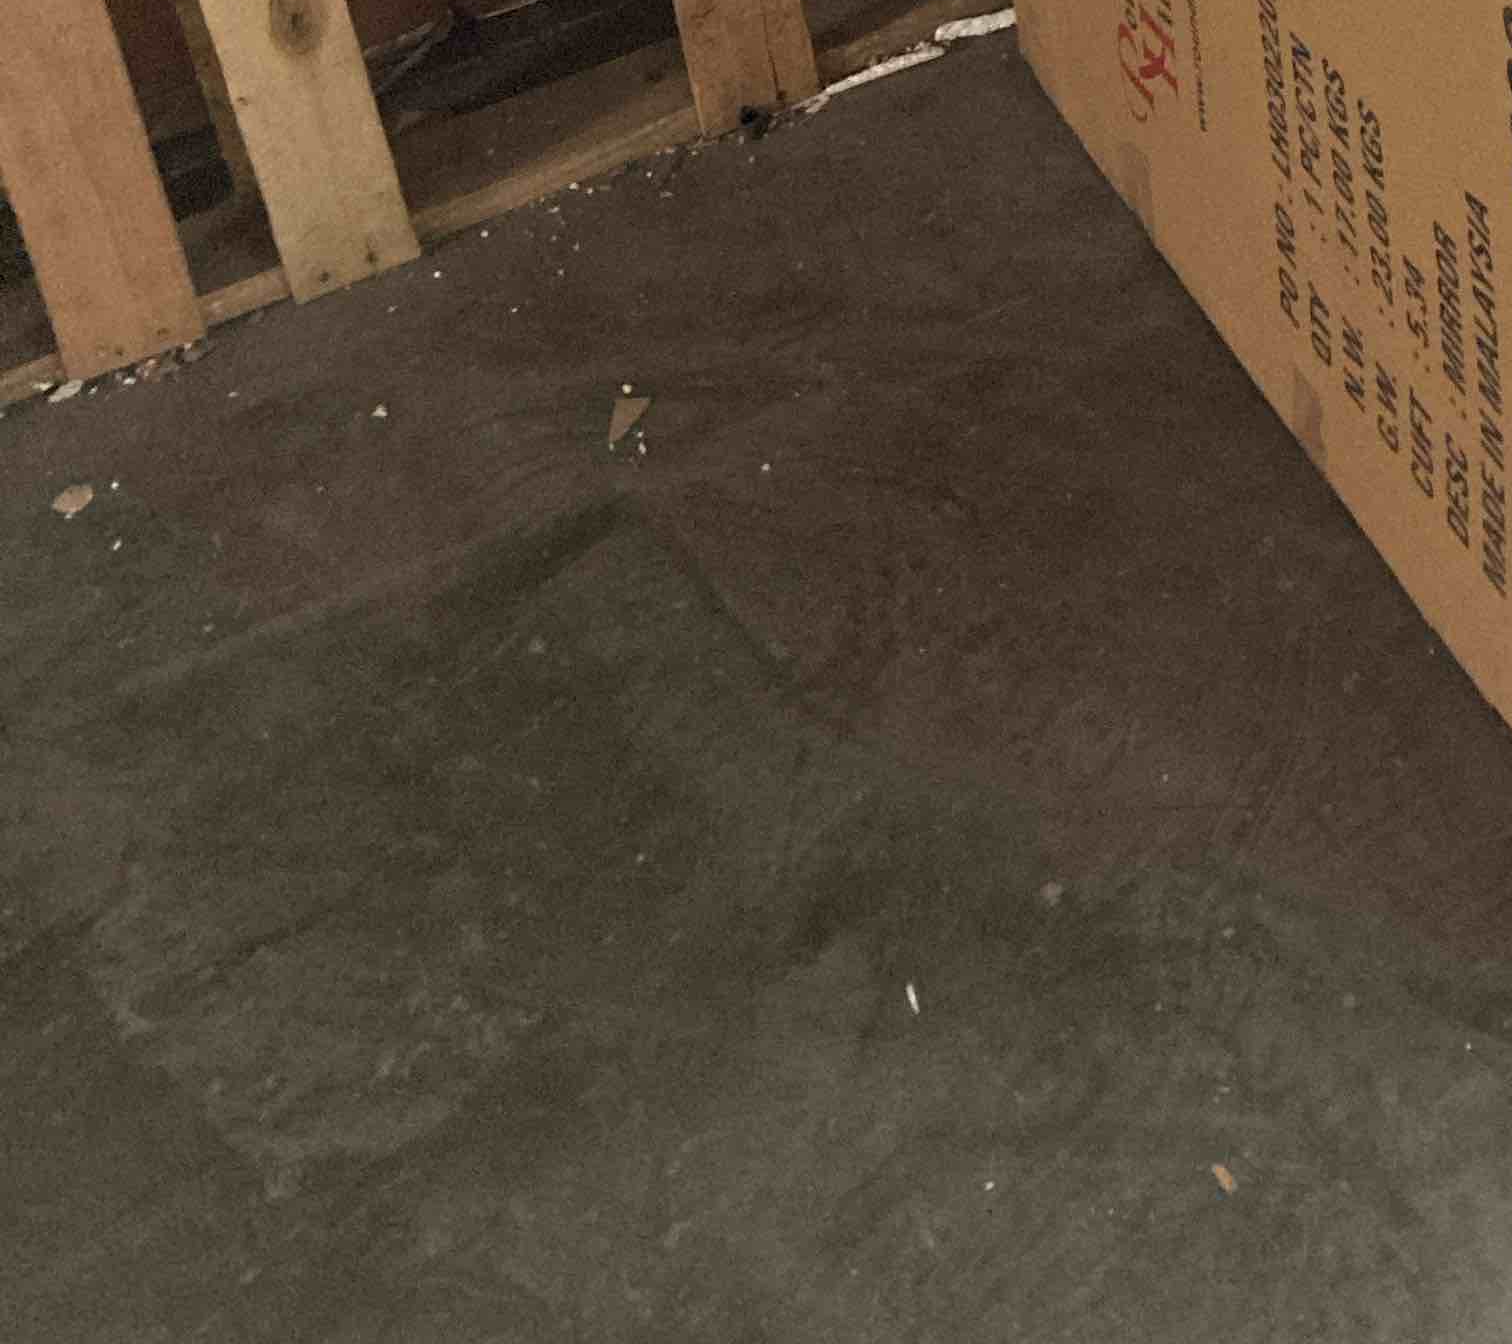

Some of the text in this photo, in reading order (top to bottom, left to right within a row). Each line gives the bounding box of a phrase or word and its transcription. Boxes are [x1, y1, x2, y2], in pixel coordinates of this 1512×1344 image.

[1320, 56, 1351, 153] KGS
[1356, 96, 1386, 191] KGS
[1274, 201, 1298, 270] NO
[1331, 147, 1359, 257] 17.00
[1364, 191, 1395, 307] 23.00
[1277, 267, 1301, 331] PO
[1307, 279, 1333, 367] QTY
[1401, 253, 1430, 349] 5.34
[1432, 219, 1467, 396] MIRROR
[1408, 384, 1434, 500] CUFT
[1464, 189, 1507, 599] MADE IN MALAYSIA
[1445, 431, 1470, 549] DESC
